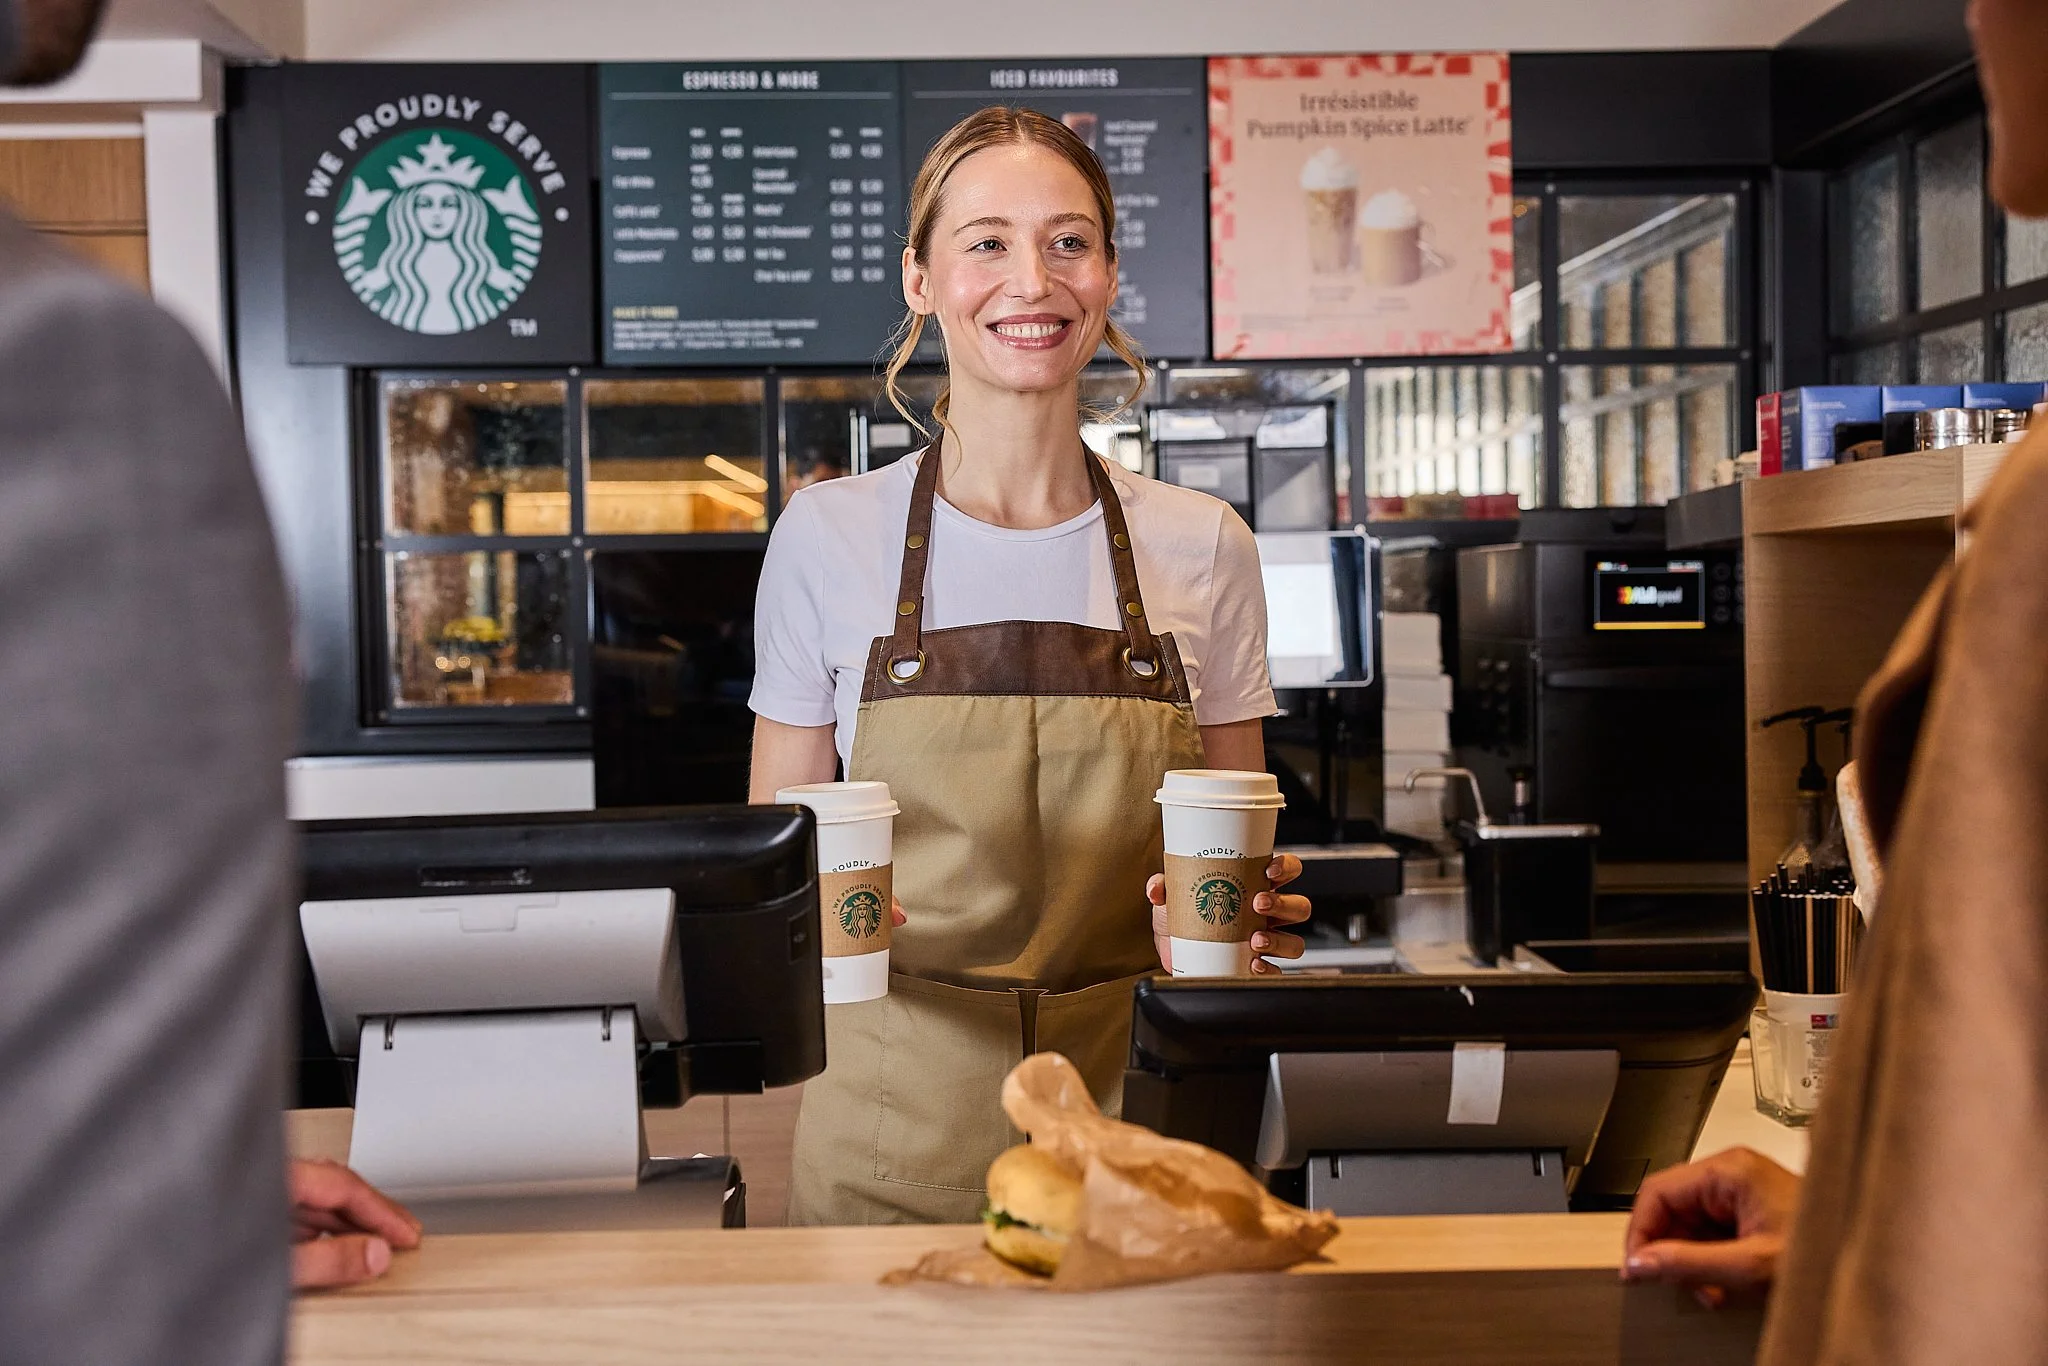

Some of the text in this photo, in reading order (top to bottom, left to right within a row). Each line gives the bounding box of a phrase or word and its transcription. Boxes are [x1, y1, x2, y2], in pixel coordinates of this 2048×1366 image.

[683, 71, 819, 89] ESPRESSO & MORE
[990, 68, 1118, 88] ICED FAVOURITES
[1300, 90, 1419, 112] Irrésistible
[1247, 117, 1346, 141] Pumpkin
[1351, 118, 1406, 140] Spice
[305, 93, 565, 198] WE PROUDLY SERVE
[508, 319, 537, 336] TM
[1198, 871, 1231, 883] PROUDLY
[1231, 875, 1247, 893] SERVE
[841, 883, 872, 898] PROUDLY
[872, 886, 886, 903] SERVE
